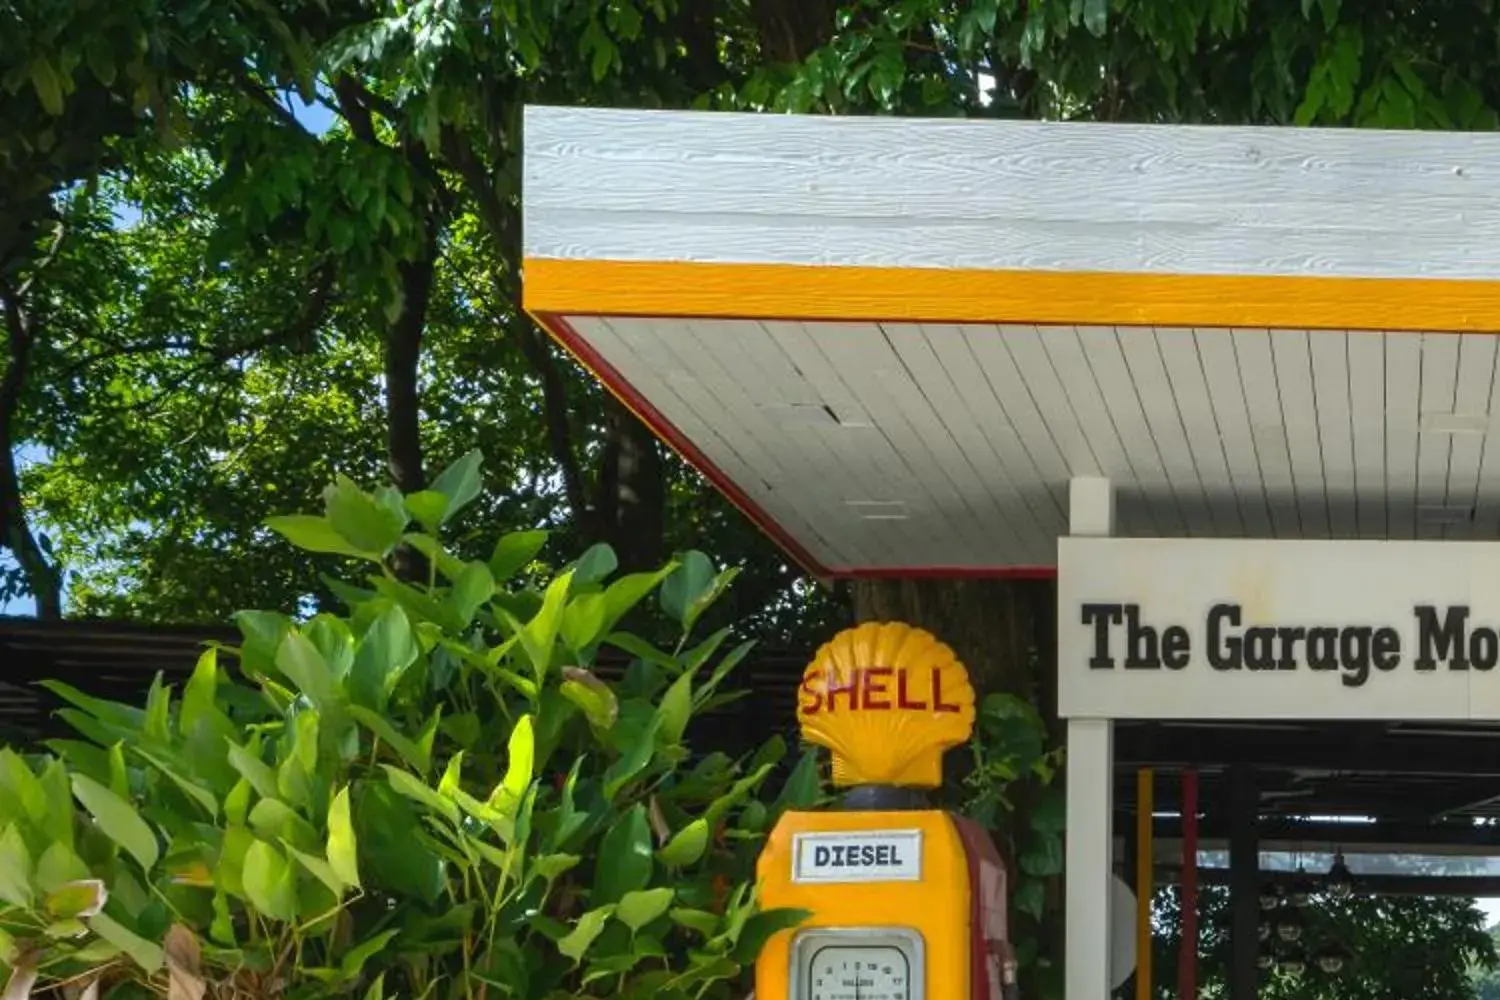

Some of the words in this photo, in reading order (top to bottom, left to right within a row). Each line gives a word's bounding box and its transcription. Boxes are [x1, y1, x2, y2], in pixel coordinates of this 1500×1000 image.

[1081, 603, 1191, 670] The
[1206, 603, 1400, 687] Garage
[800, 666, 961, 715] SHELL
[814, 844, 903, 868] DIESEL
